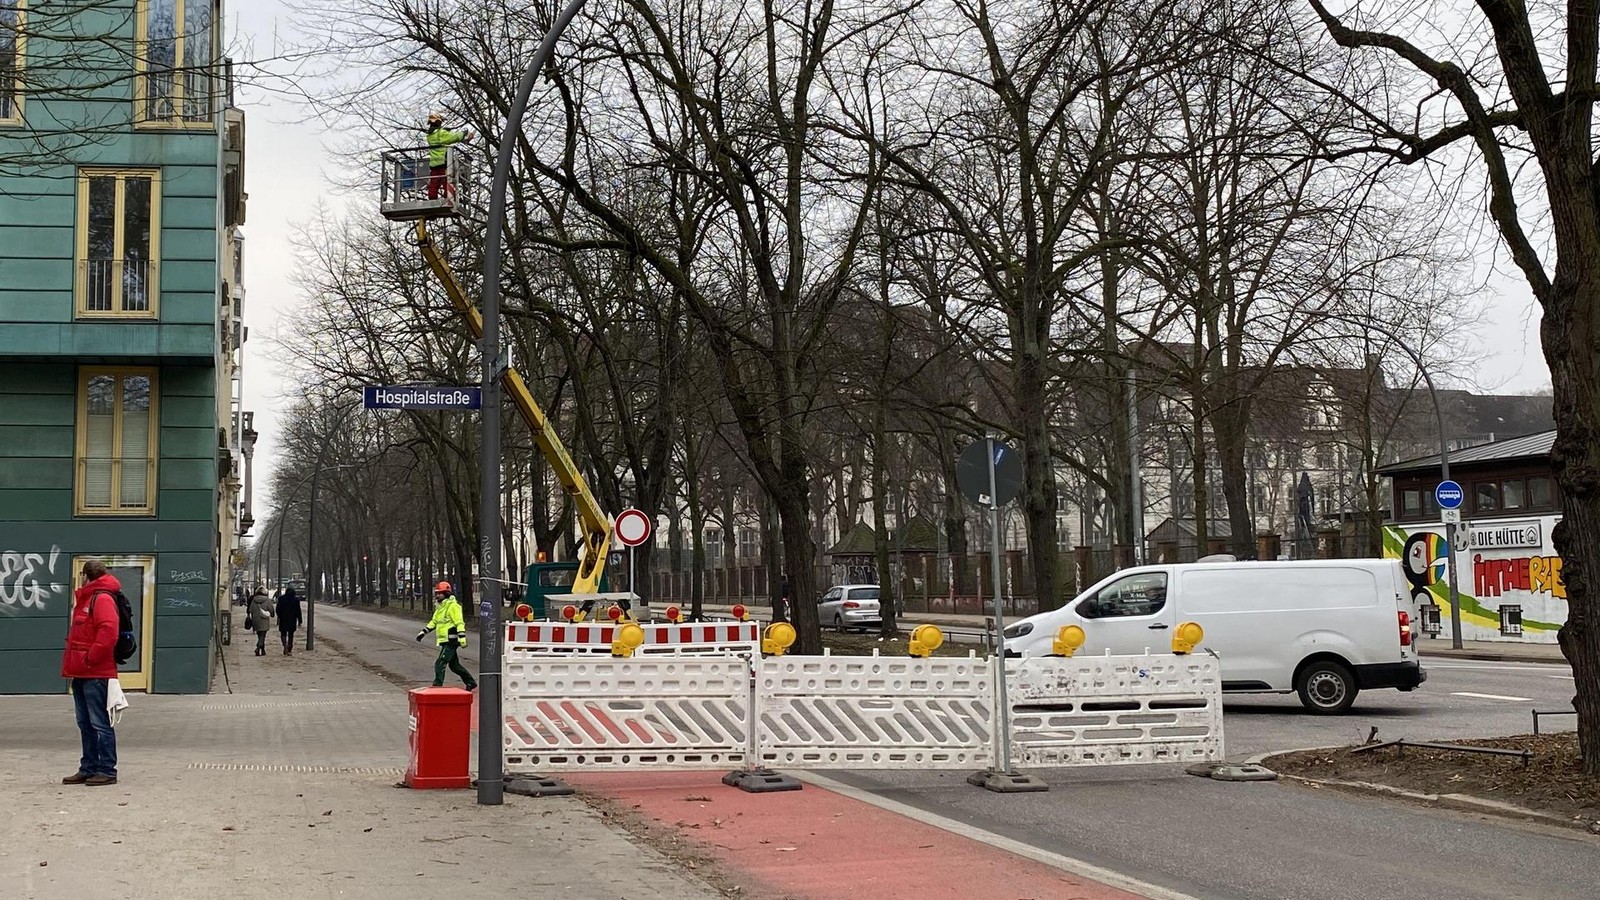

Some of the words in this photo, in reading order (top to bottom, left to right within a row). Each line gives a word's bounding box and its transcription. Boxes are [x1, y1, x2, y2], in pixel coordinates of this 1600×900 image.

[375, 389, 470, 407] Hospitalstraße
[1478, 531, 1493, 546] DIE
[1495, 527, 1525, 545] HÜTTE
